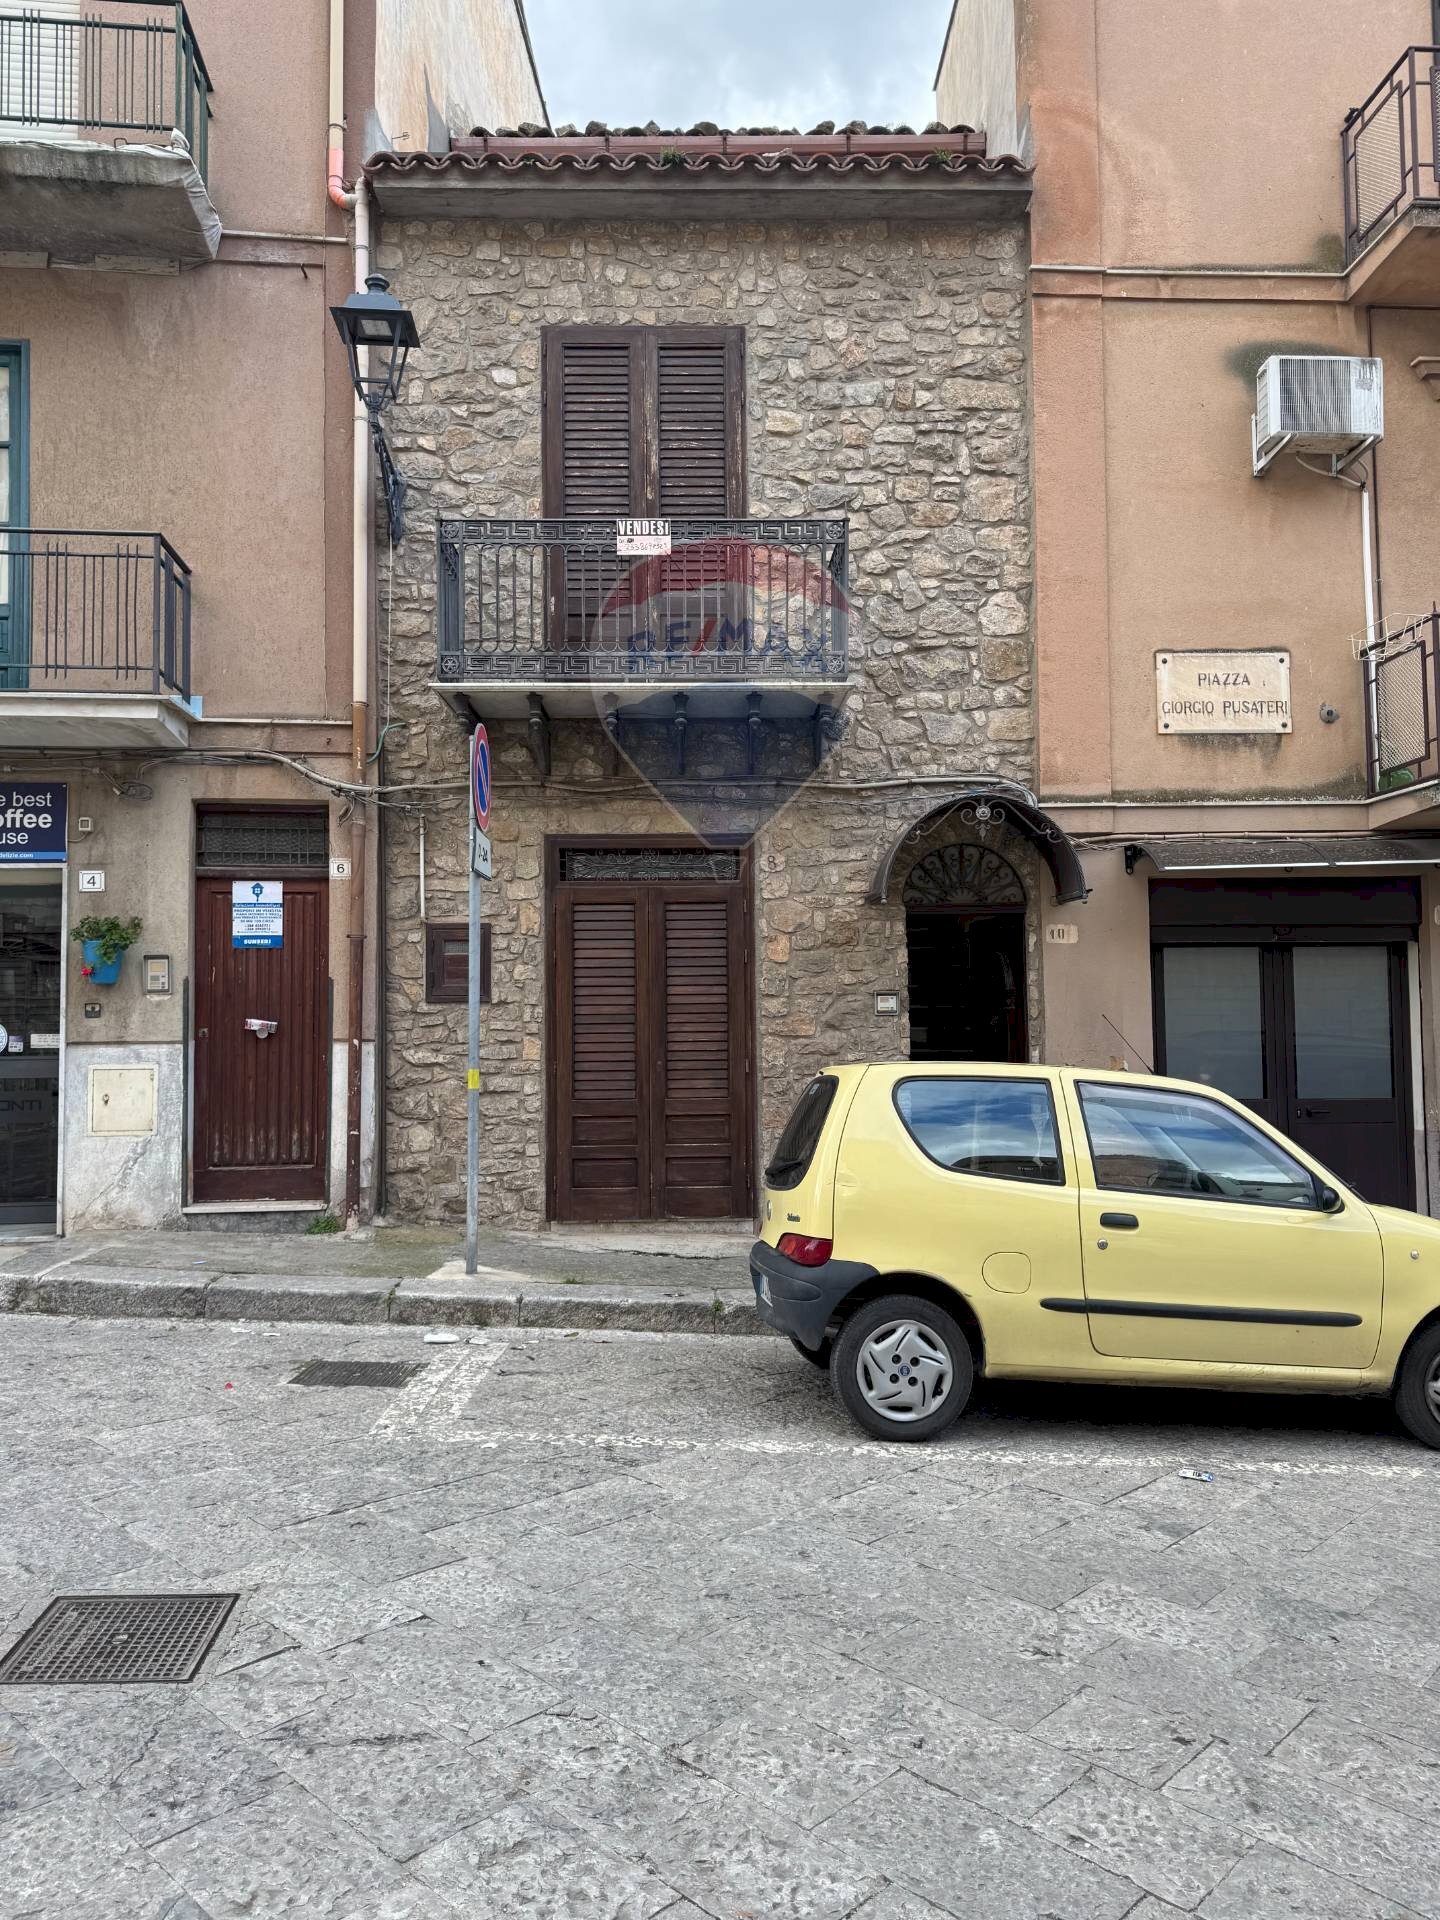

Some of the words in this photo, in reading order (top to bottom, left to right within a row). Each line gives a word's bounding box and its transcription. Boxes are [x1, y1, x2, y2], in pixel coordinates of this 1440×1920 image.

[618, 520, 669, 536] VENDESI
[1197, 672, 1251, 687] PIAZZA
[1161, 700, 1215, 716] GIORGIO
[1222, 700, 1288, 716] PUSATERI
[12, 791, 53, 807] best
[336, 863, 345, 874] 6
[767, 855, 777, 871] 8
[86, 875, 97, 887] 4
